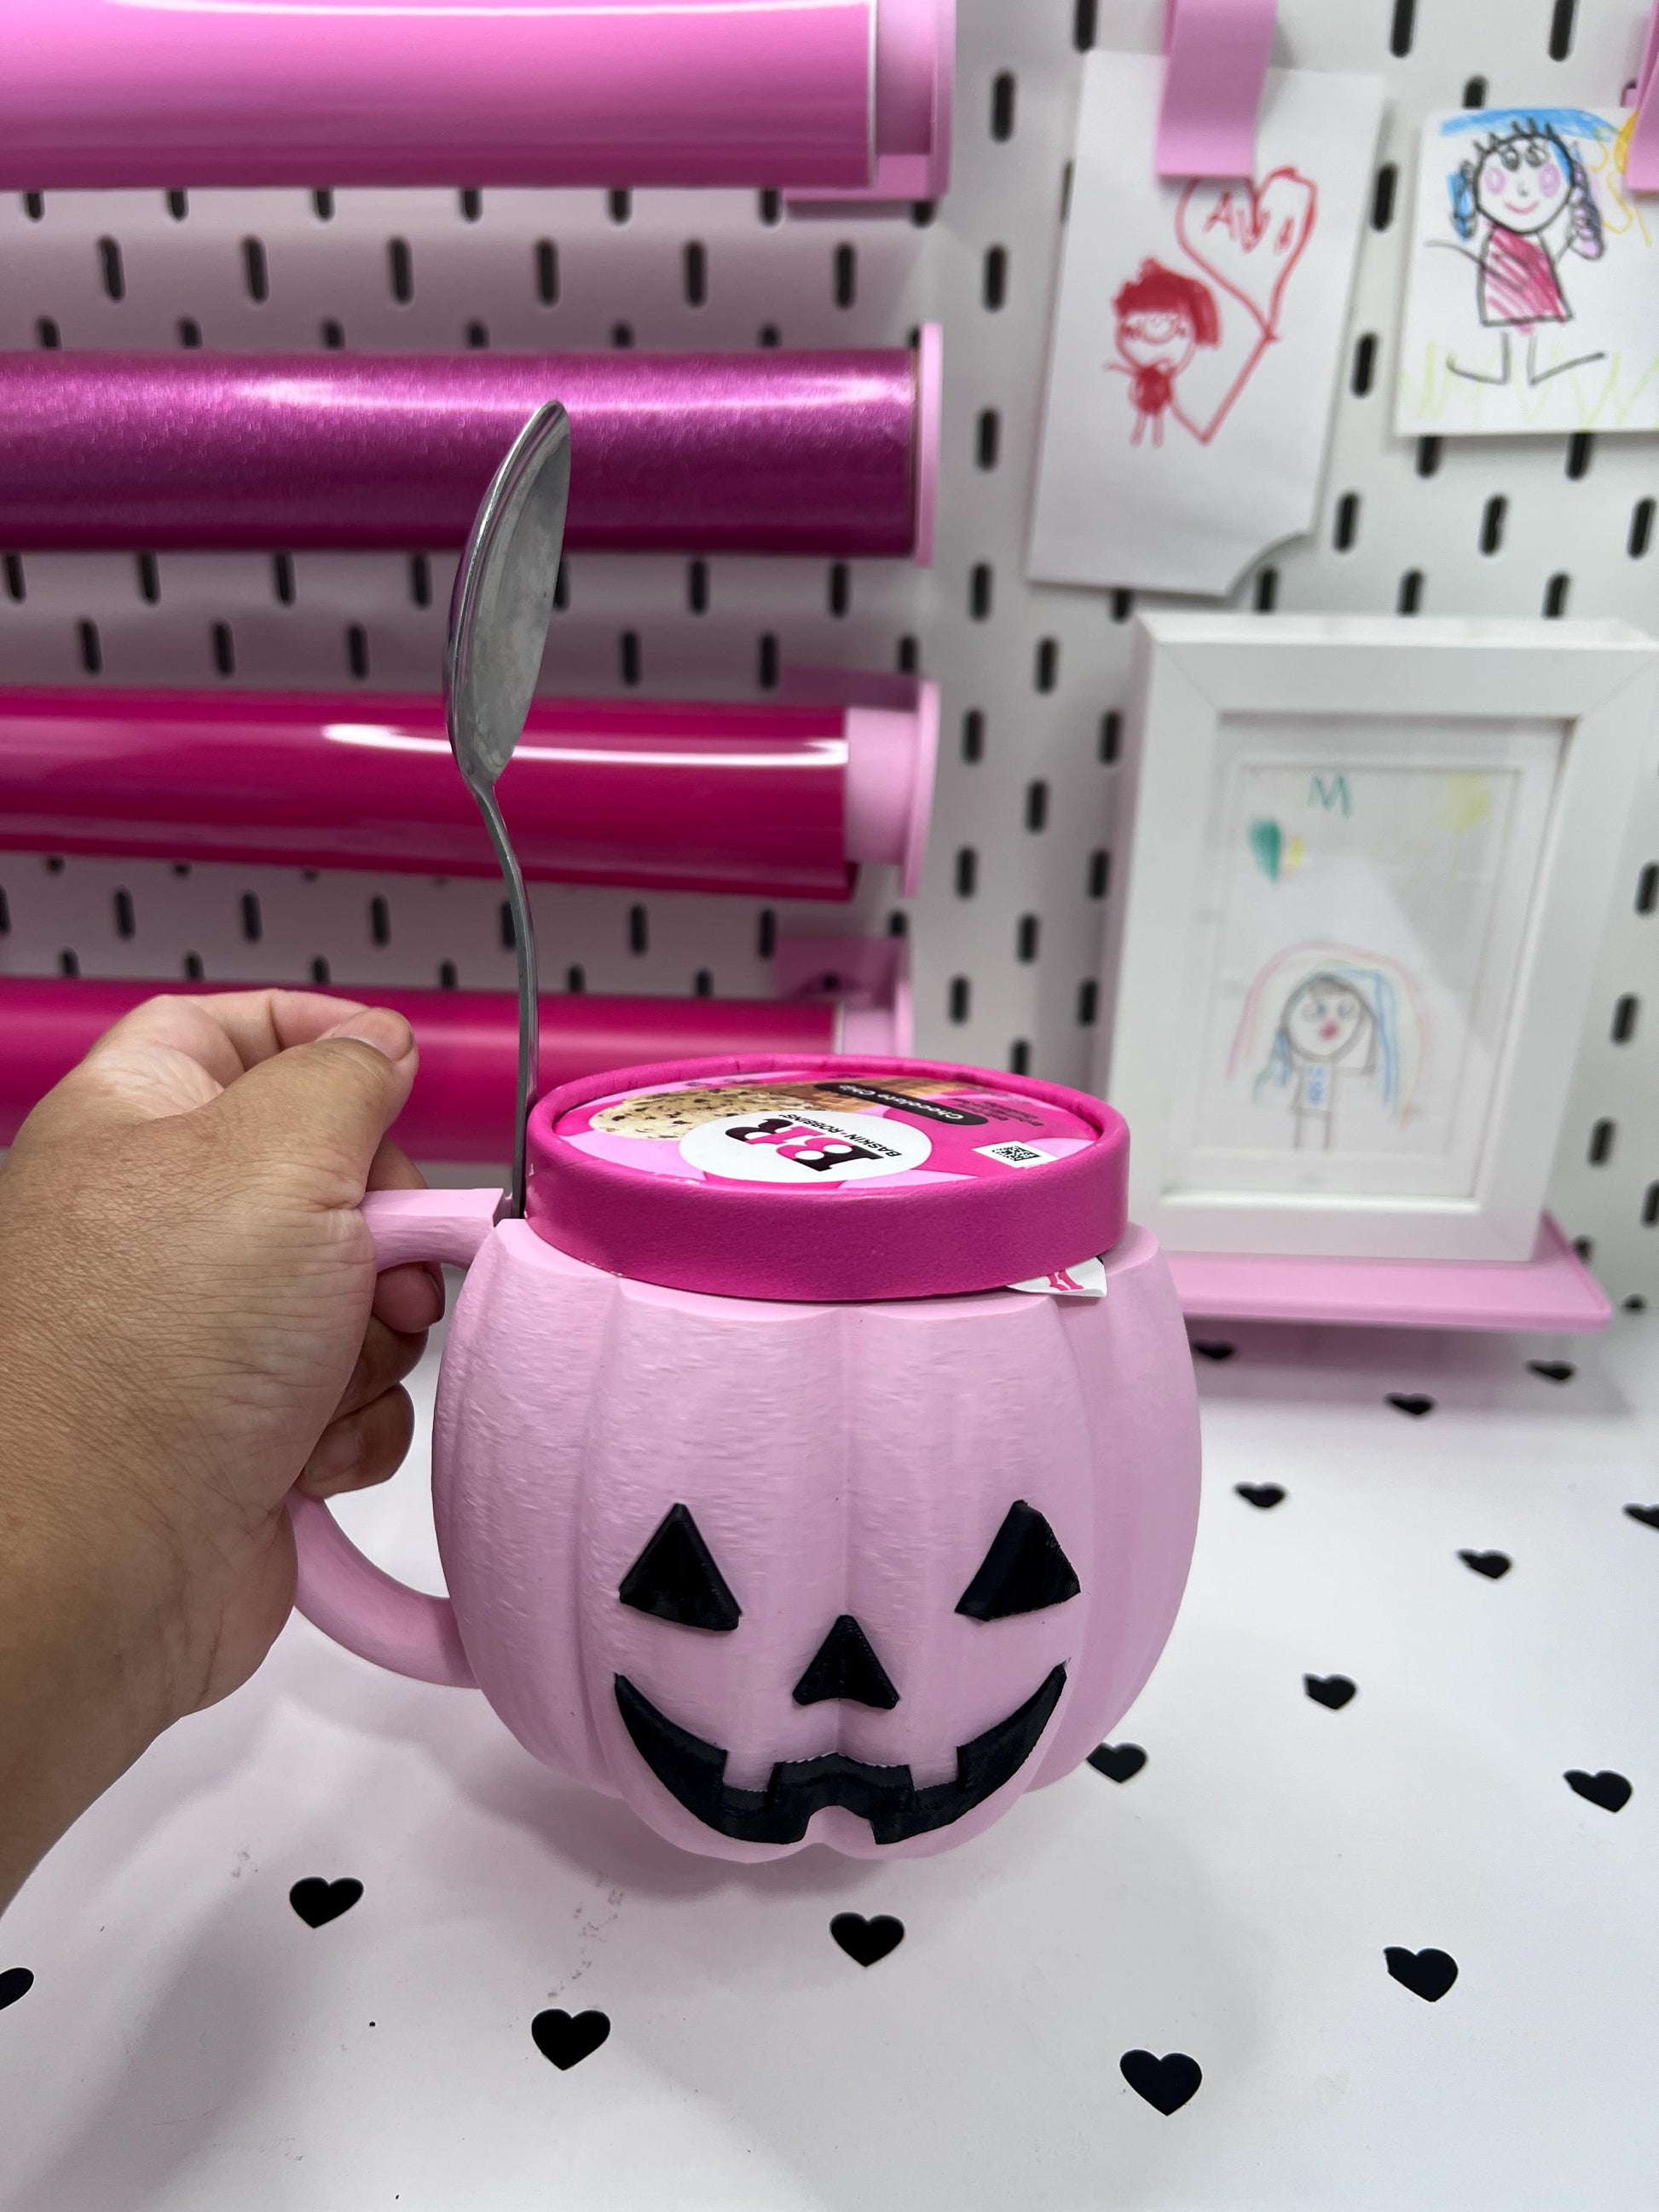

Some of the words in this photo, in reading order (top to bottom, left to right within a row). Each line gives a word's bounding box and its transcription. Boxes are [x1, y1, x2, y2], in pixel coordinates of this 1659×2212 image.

[1307, 772, 1353, 820] M
[839, 1084, 874, 1096] Chip
[877, 1094, 964, 1120] Chocolate
[725, 1118, 885, 1172] BR
